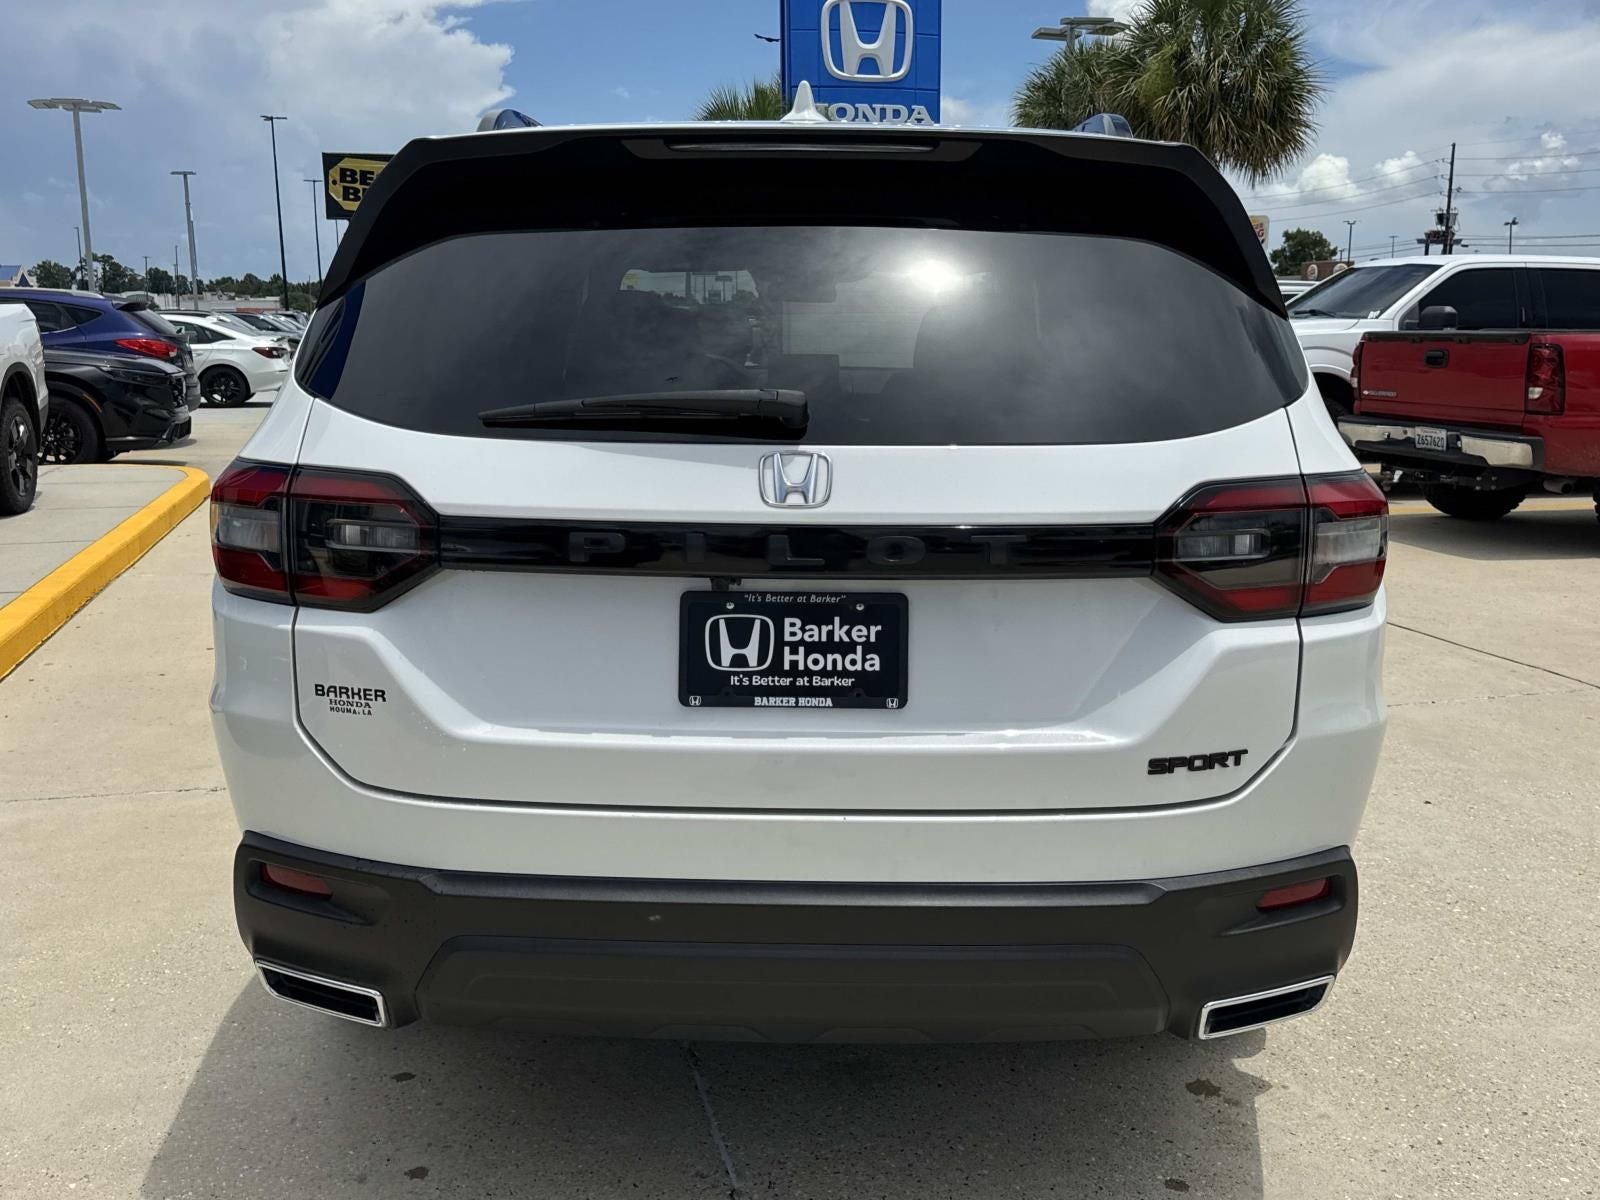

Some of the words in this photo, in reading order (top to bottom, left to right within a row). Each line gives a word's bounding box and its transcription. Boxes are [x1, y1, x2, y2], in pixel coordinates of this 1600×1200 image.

[569, 531, 1027, 566] PILOT
[765, 594, 795, 603] Better
[783, 616, 882, 643] Barker
[783, 645, 881, 671] Honda
[730, 674, 749, 686] It's
[752, 675, 793, 686] Better
[795, 676, 809, 686] at
[812, 676, 855, 687] Barker
[329, 698, 372, 709] HONDA
[754, 696, 796, 706] BARKER
[798, 697, 833, 707] HONDA
[1147, 748, 1249, 775] SPORT
